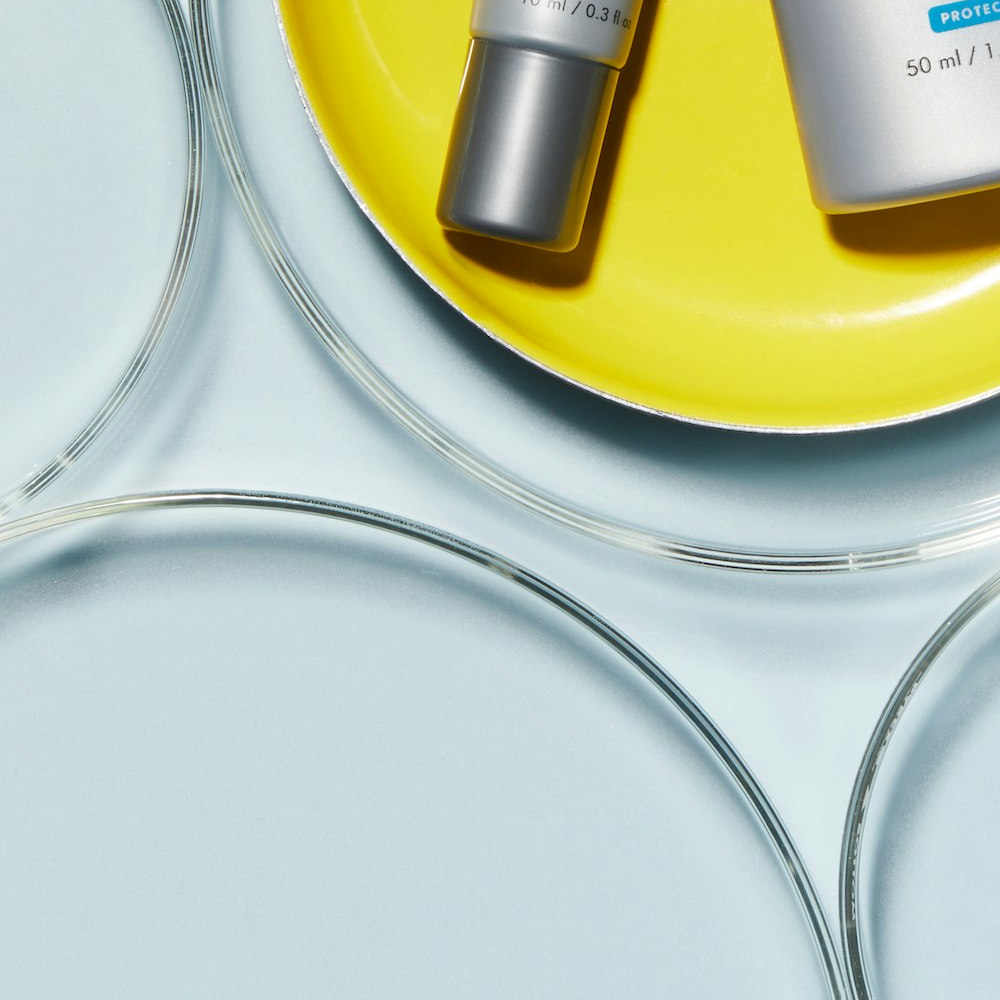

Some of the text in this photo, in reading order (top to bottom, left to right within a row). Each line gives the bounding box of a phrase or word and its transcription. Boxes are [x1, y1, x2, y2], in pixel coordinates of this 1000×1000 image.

[572, 0, 582, 15] /
[586, 3, 609, 23] 0.3
[613, 9, 620, 26] fl
[622, 18, 632, 30] oz
[907, 56, 932, 78] 50
[940, 48, 961, 71] ml
[969, 46, 976, 66] /
